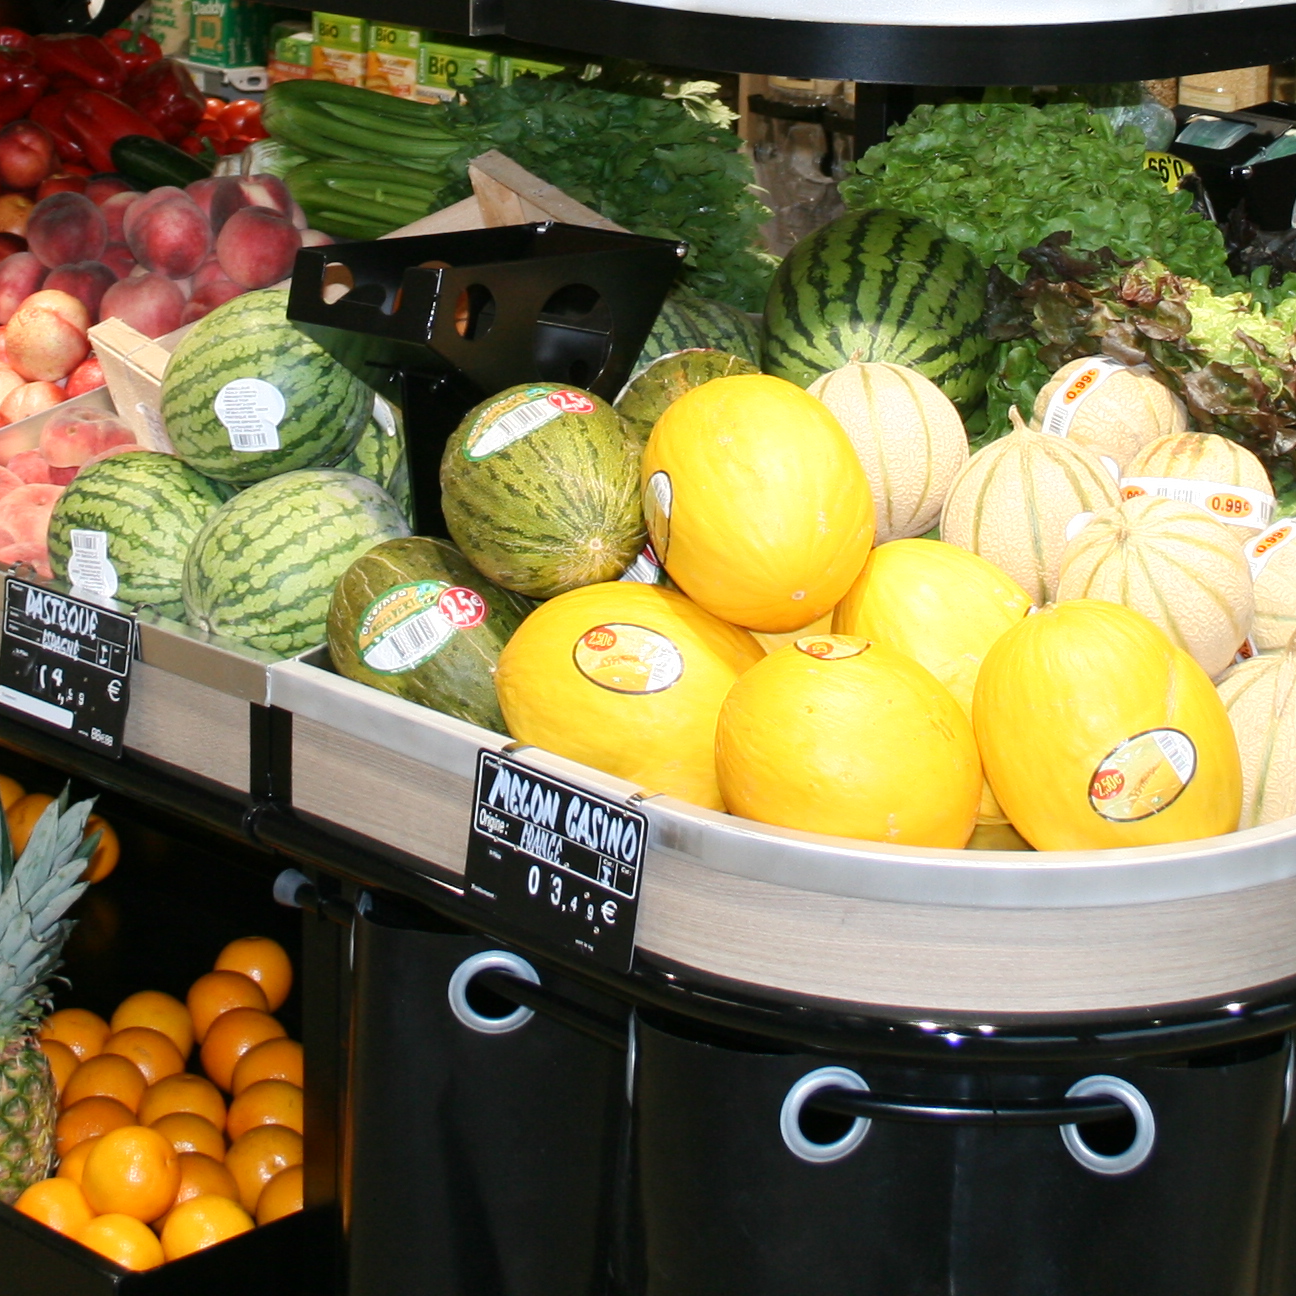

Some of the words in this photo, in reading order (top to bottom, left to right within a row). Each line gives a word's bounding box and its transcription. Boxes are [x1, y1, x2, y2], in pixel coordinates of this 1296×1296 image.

[192, 0, 226, 17] Daddy
[319, 23, 339, 39] BiO
[376, 27, 397, 44] BiO
[428, 56, 459, 80] BiO
[25, 588, 99, 641] PASTEQUE
[107, 679, 122, 702] €
[488, 766, 560, 830] MELON
[520, 823, 564, 865] FRANCE
